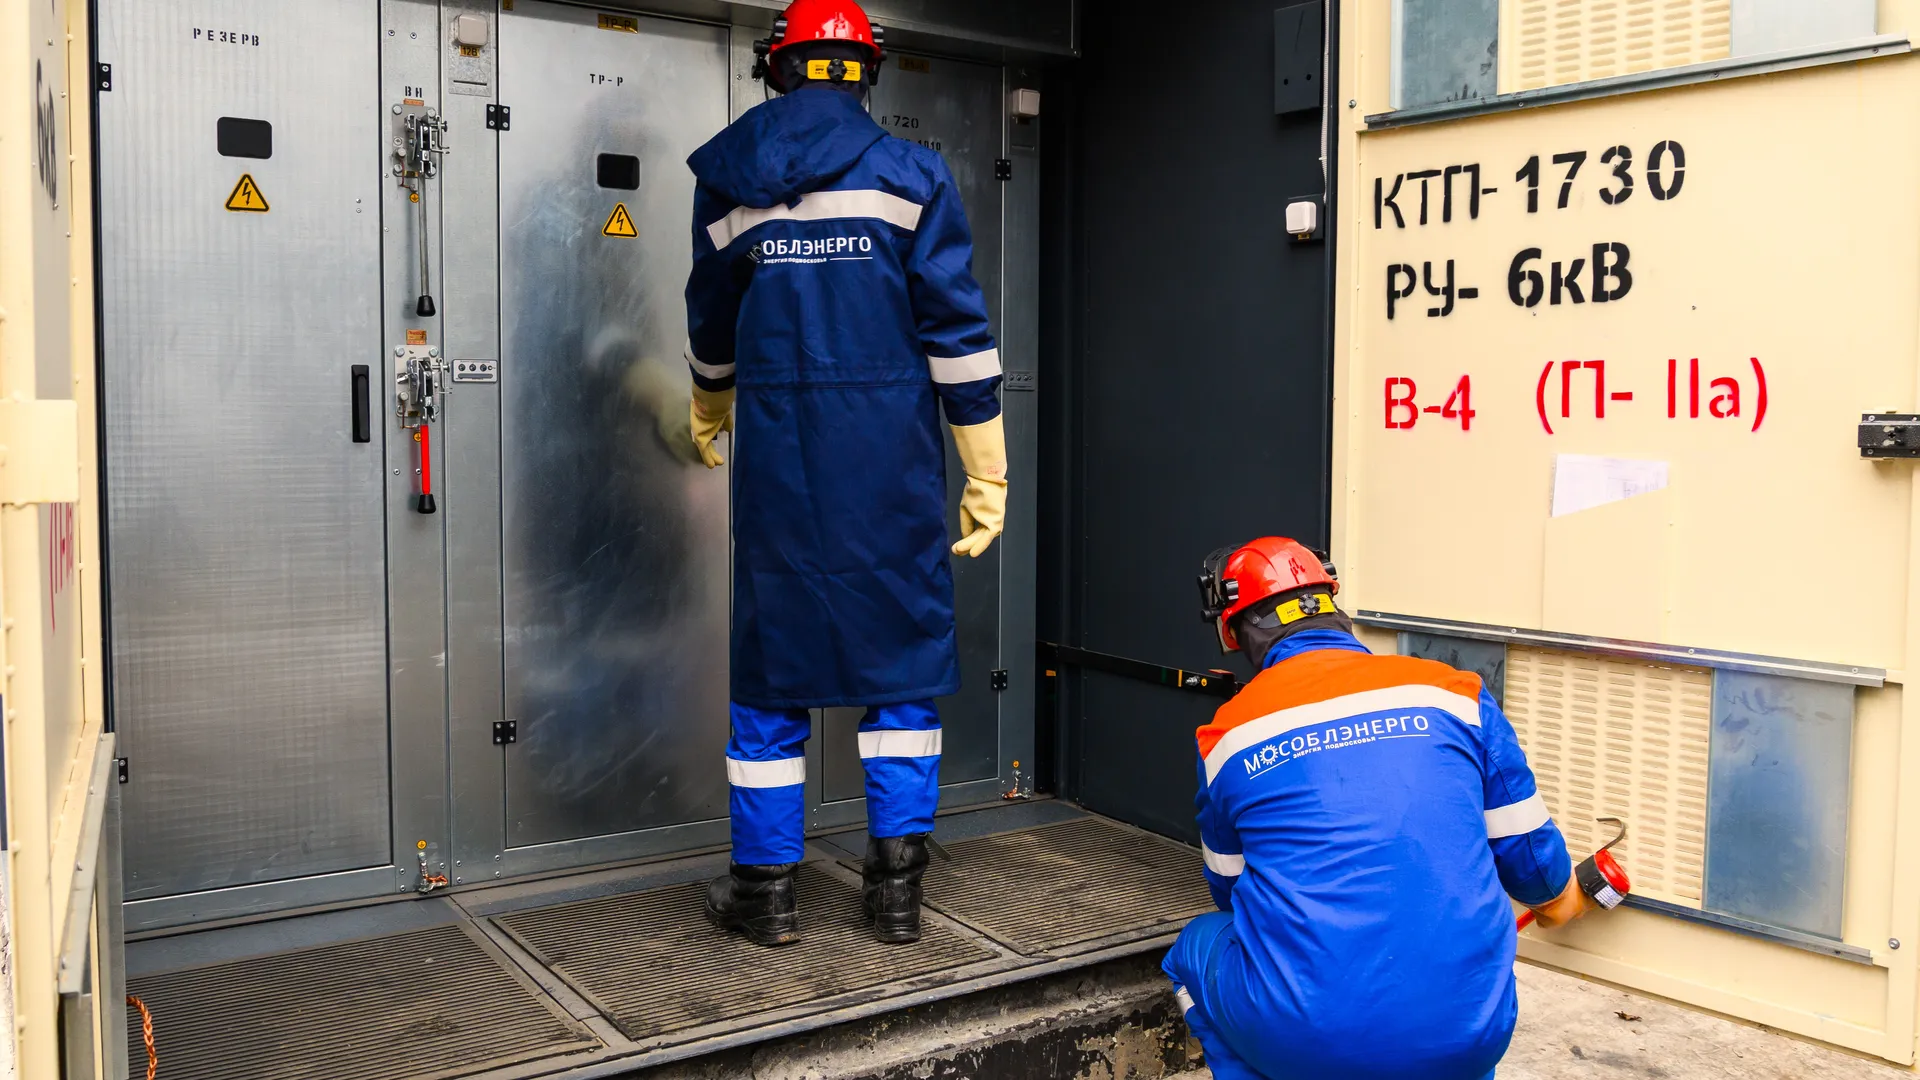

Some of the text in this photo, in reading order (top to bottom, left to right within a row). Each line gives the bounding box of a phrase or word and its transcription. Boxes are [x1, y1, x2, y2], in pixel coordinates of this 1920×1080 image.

[193, 27, 260, 47] РЕЗЕРВ
[404, 85, 422, 98] ВН
[893, 114, 919, 129] 720
[1507, 242, 1633, 308] 6кВ
[1384, 374, 1476, 431] В-4
[1292, 736, 1377, 759] ЭНЕРГИЯ ПОДМОСКОВЬЯ
